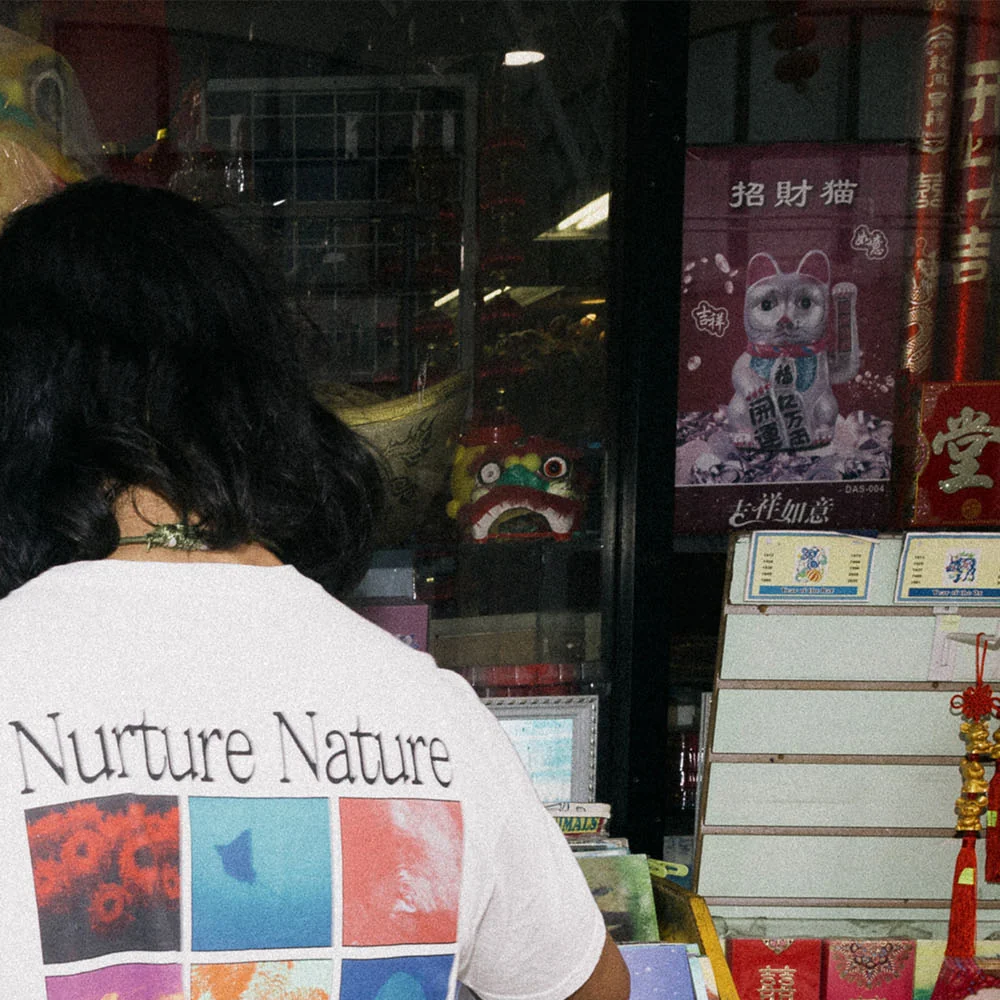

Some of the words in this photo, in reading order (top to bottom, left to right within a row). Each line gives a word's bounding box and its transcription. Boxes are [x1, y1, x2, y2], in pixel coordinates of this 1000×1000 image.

[729, 179, 858, 209] 招財猫
[9, 709, 255, 795] Nurture
[272, 710, 454, 788] Nature
